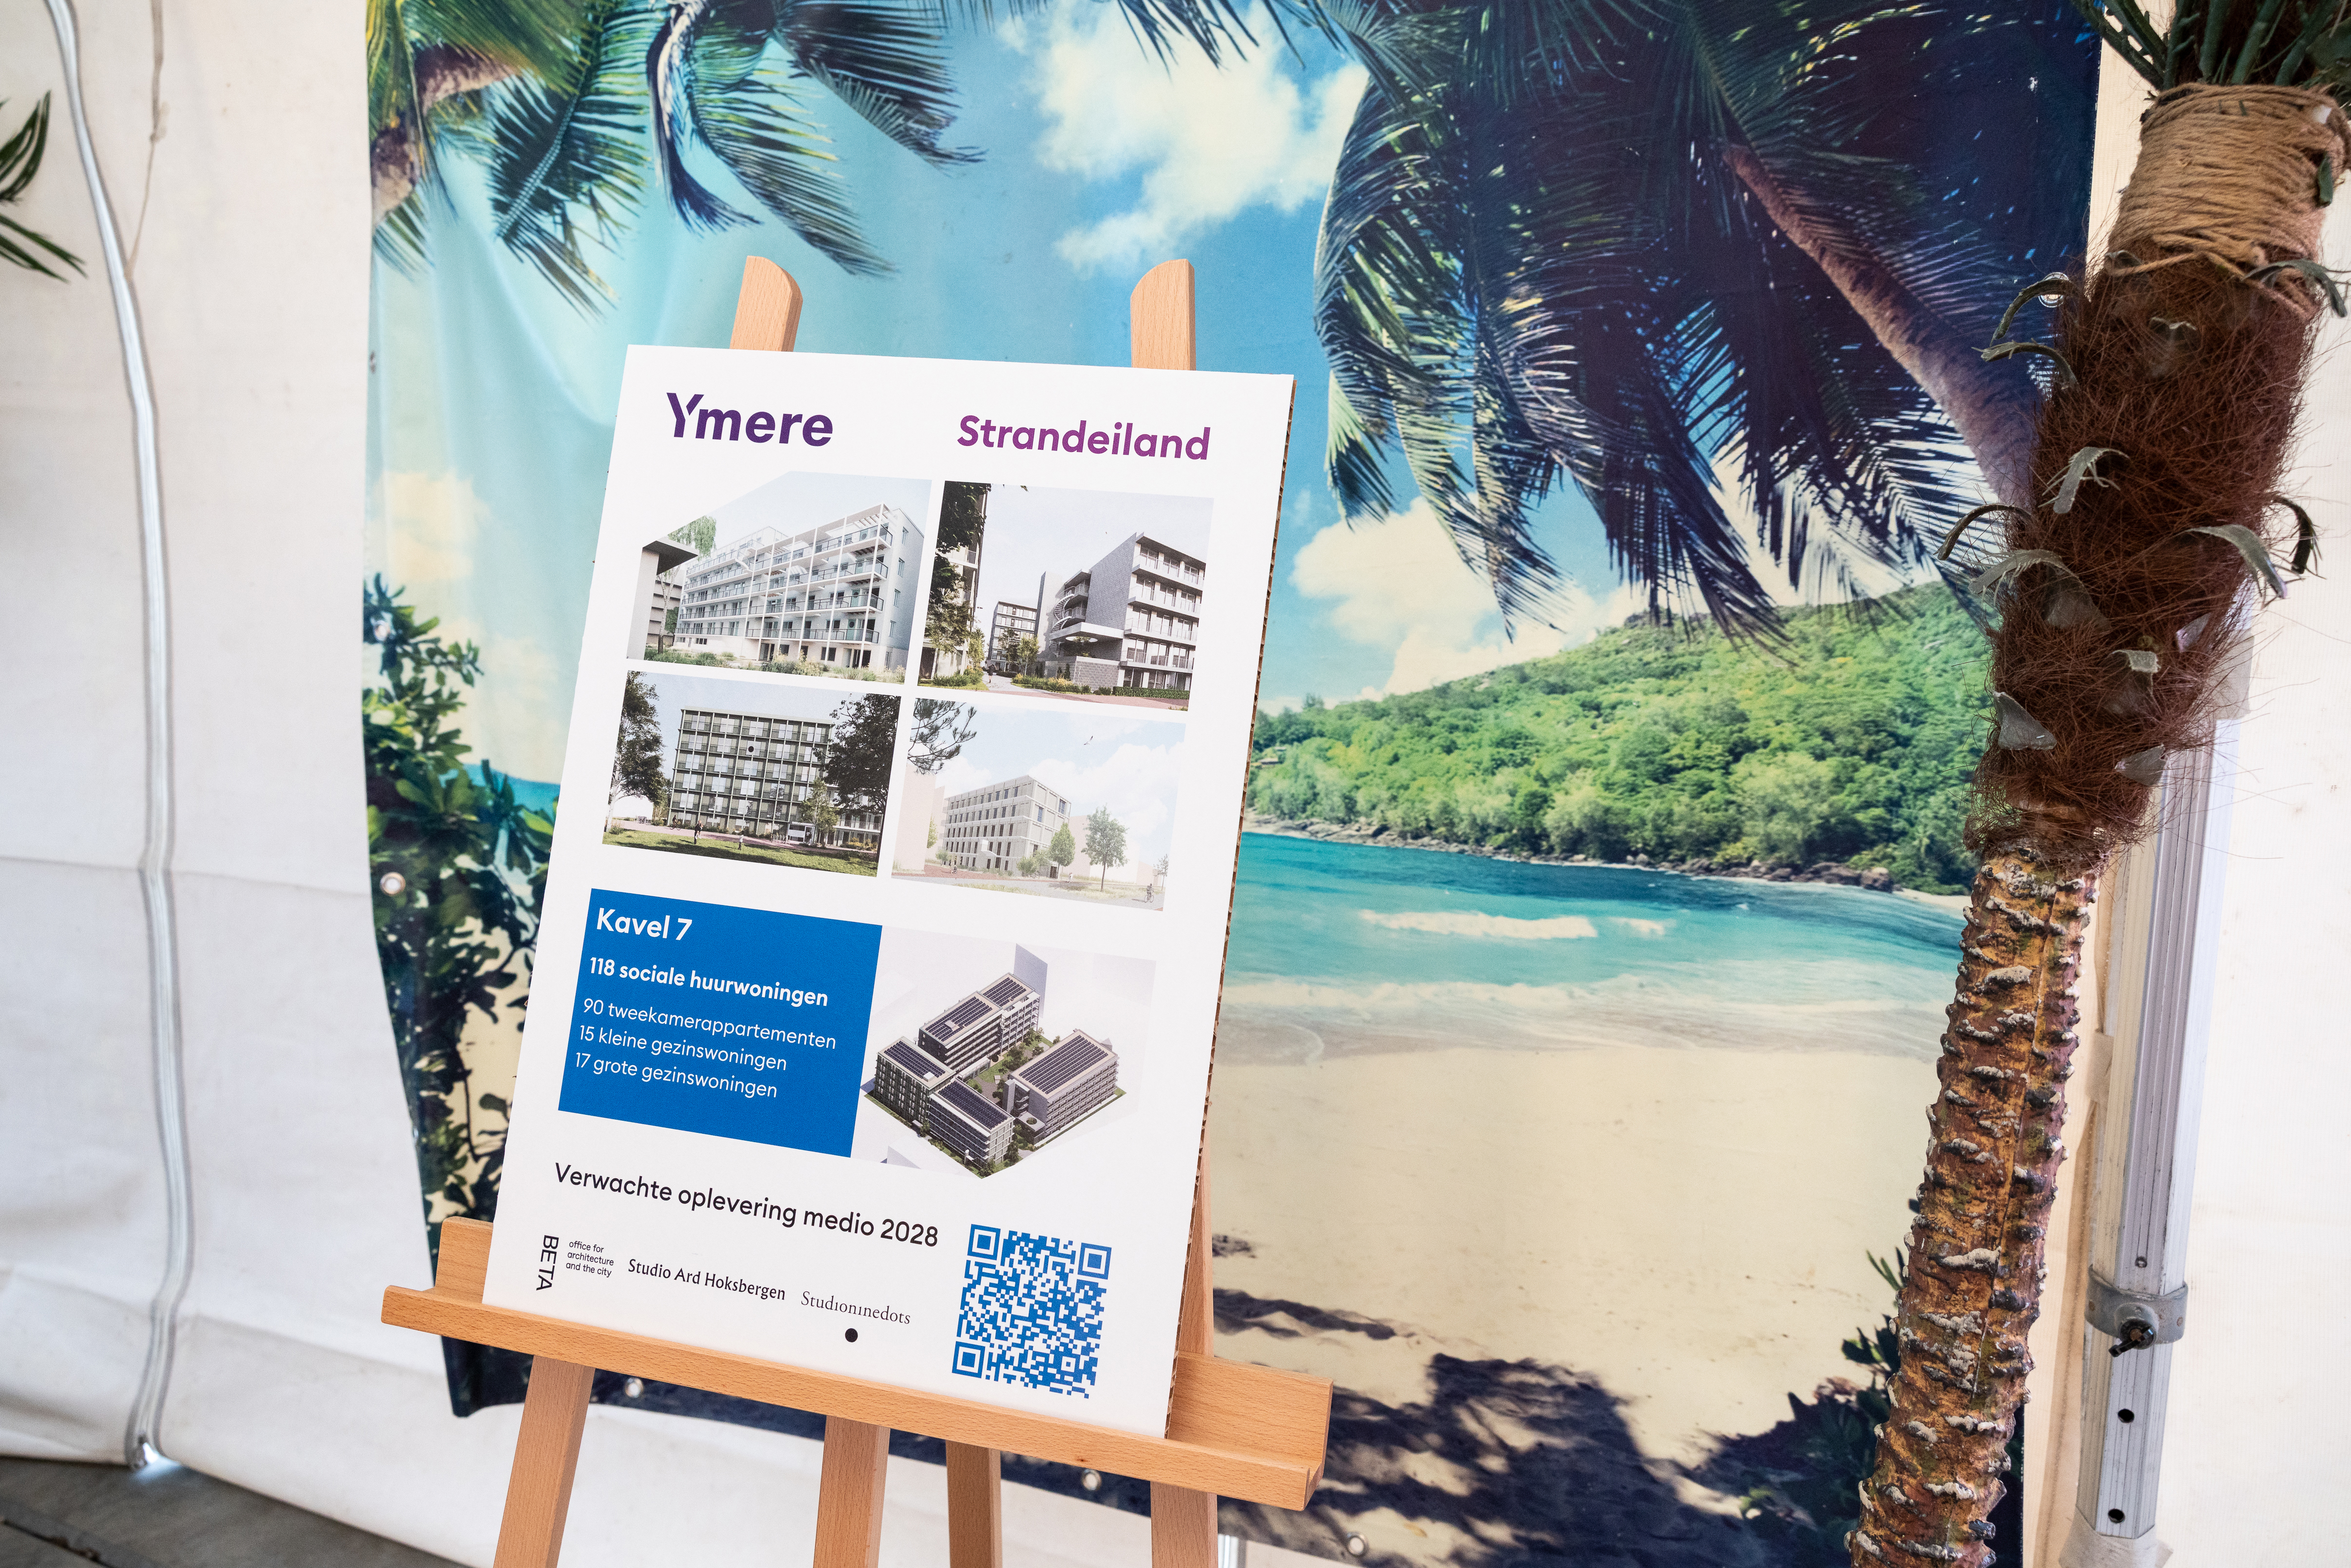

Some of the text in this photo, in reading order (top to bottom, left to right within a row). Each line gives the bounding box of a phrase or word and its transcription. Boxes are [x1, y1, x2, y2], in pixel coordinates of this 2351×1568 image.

[666, 392, 833, 446] Ymere
[957, 415, 1211, 460] Strandeiland
[596, 907, 693, 941] Kavel 7
[590, 957, 828, 1007] 118 sociale huurwoningen
[583, 998, 836, 1049] 90 tweekamerappartementen
[580, 1025, 787, 1071] 15 kleine gezinswoningen
[576, 1052, 777, 1099] 17 grote gezinswoningen
[555, 1162, 938, 1247] Verwachte oplevering medio 2028
[536, 1235, 559, 1291] BETA
[567, 1252, 614, 1266] architecture
[569, 1240, 604, 1253] office for
[566, 1262, 612, 1278] and the city
[628, 1258, 785, 1300] Studio Ard Hoksbergen
